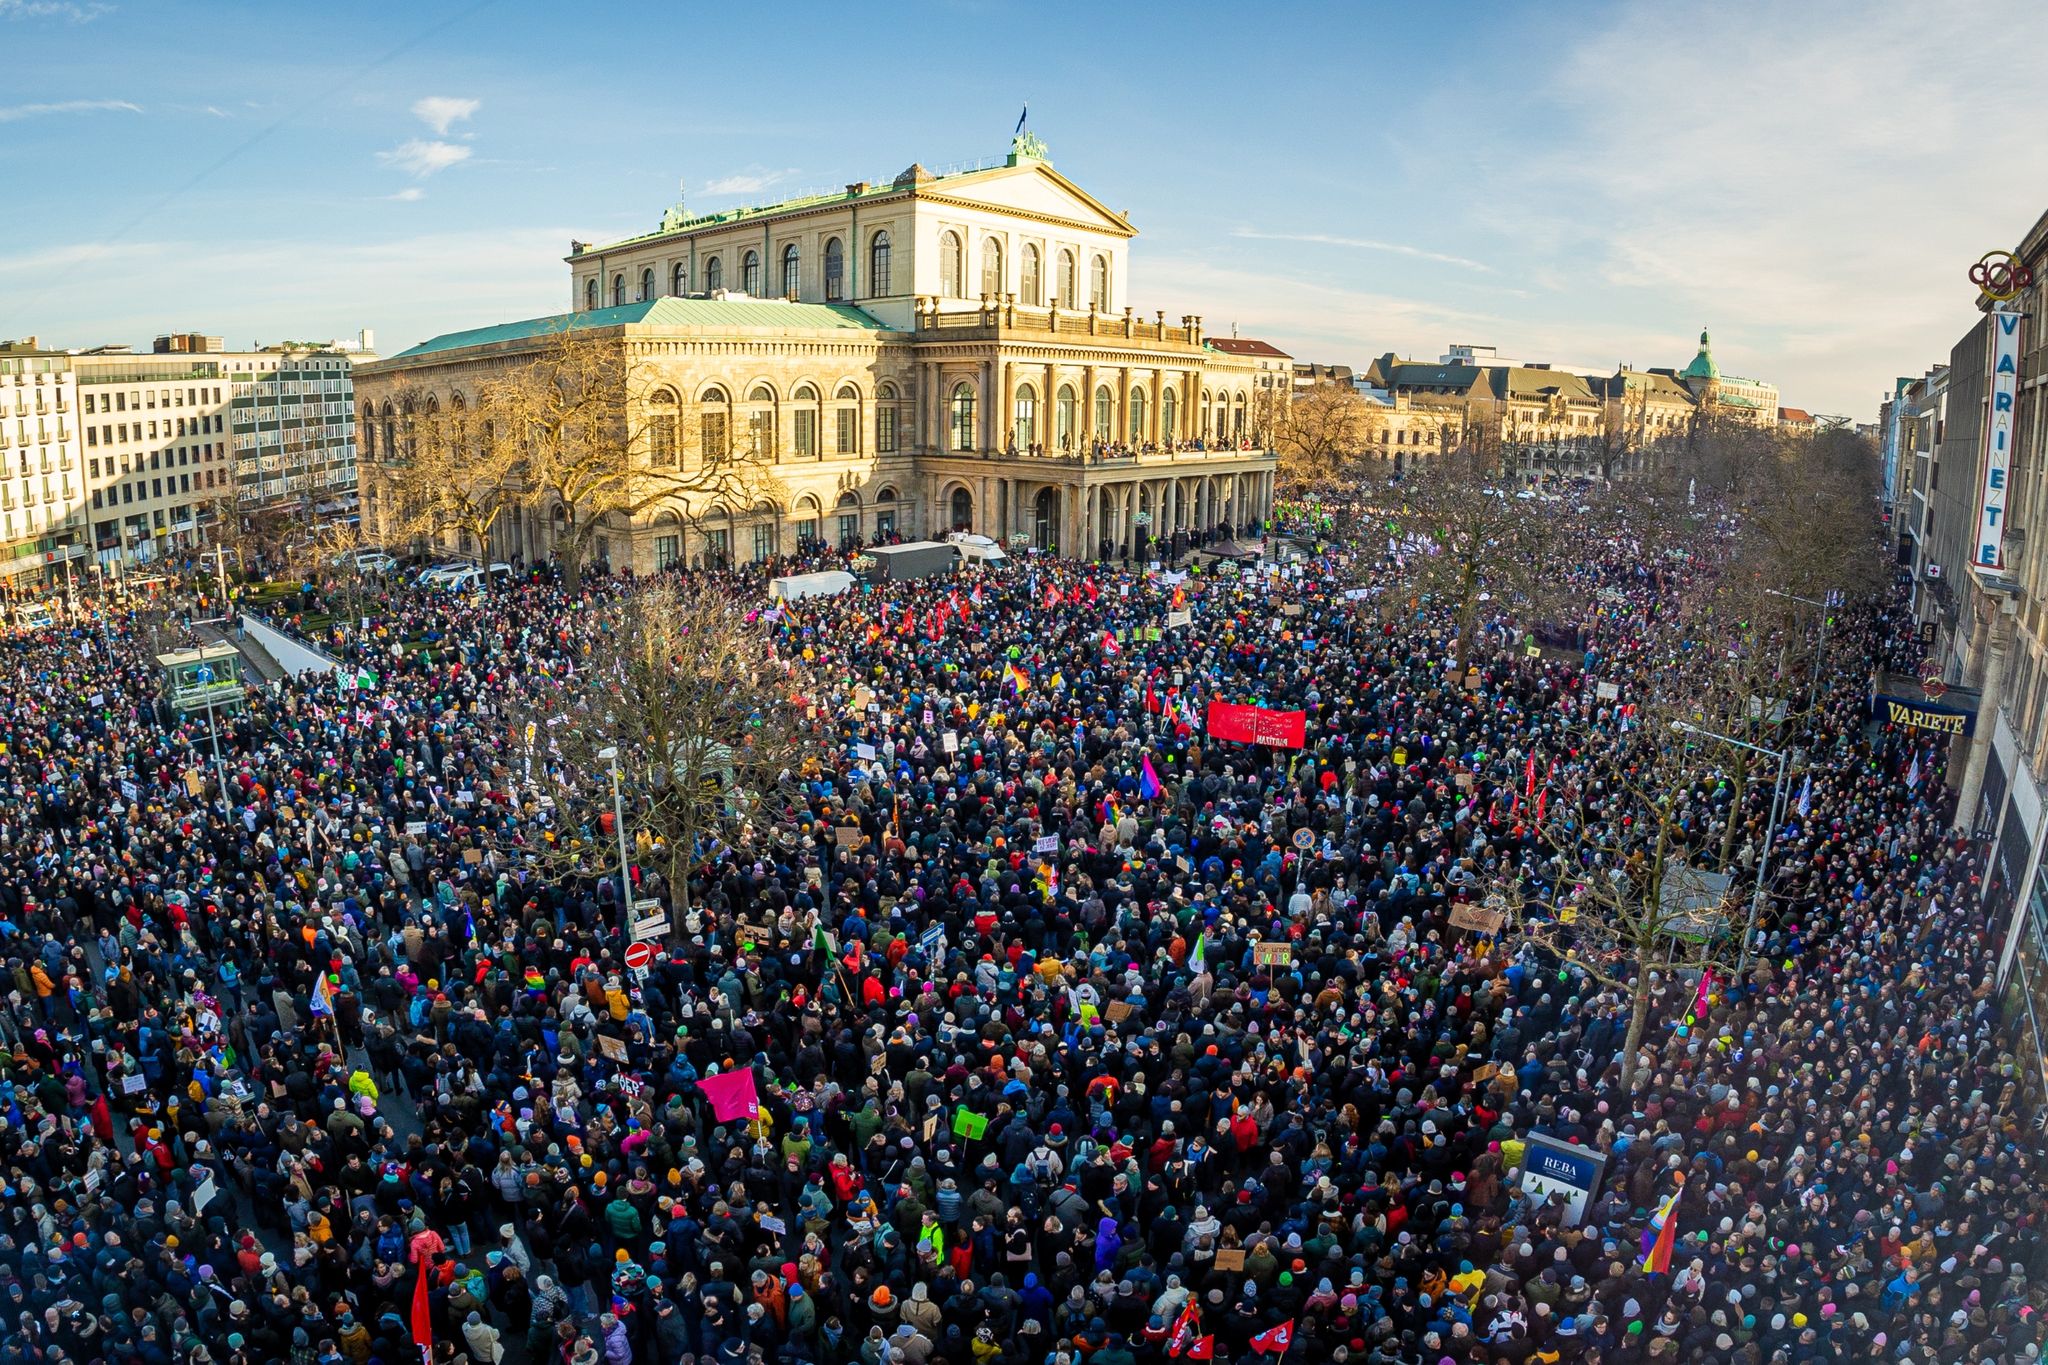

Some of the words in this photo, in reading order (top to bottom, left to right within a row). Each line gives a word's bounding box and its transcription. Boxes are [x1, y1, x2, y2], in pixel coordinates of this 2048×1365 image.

[1887, 701, 1967, 735] VARIETE
[1255, 952, 1289, 965] KINDER
[1544, 1156, 1577, 1177] REBA
